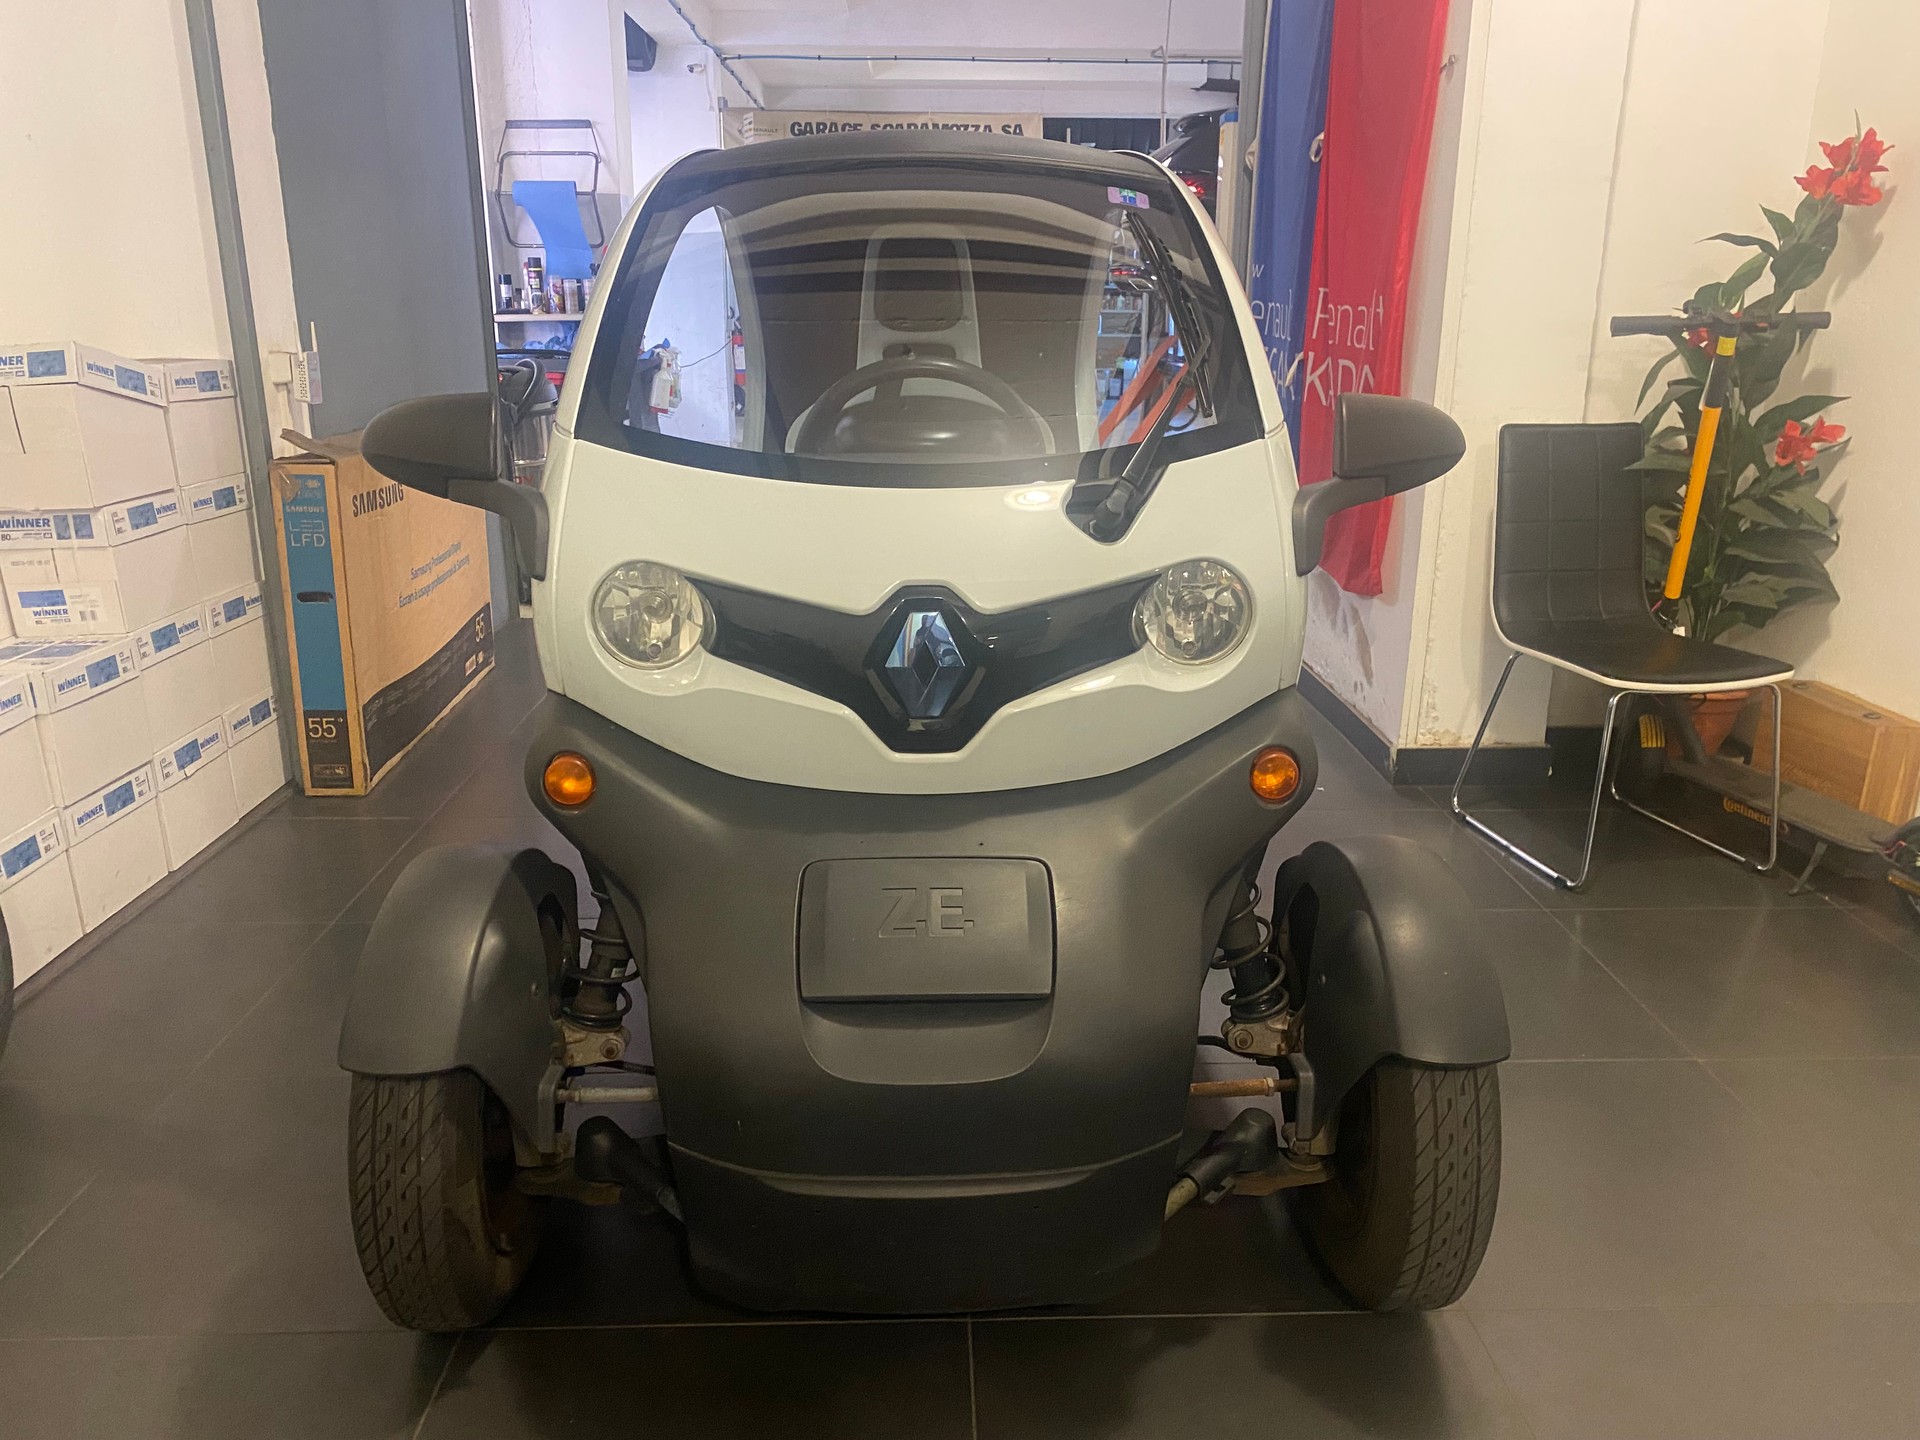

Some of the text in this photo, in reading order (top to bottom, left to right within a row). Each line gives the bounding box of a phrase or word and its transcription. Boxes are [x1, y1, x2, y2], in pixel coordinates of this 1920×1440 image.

[790, 121, 863, 136] GARAGE
[1001, 123, 1024, 136] SA
[351, 482, 404, 518] SAMSUNG
[291, 533, 325, 547] LFD
